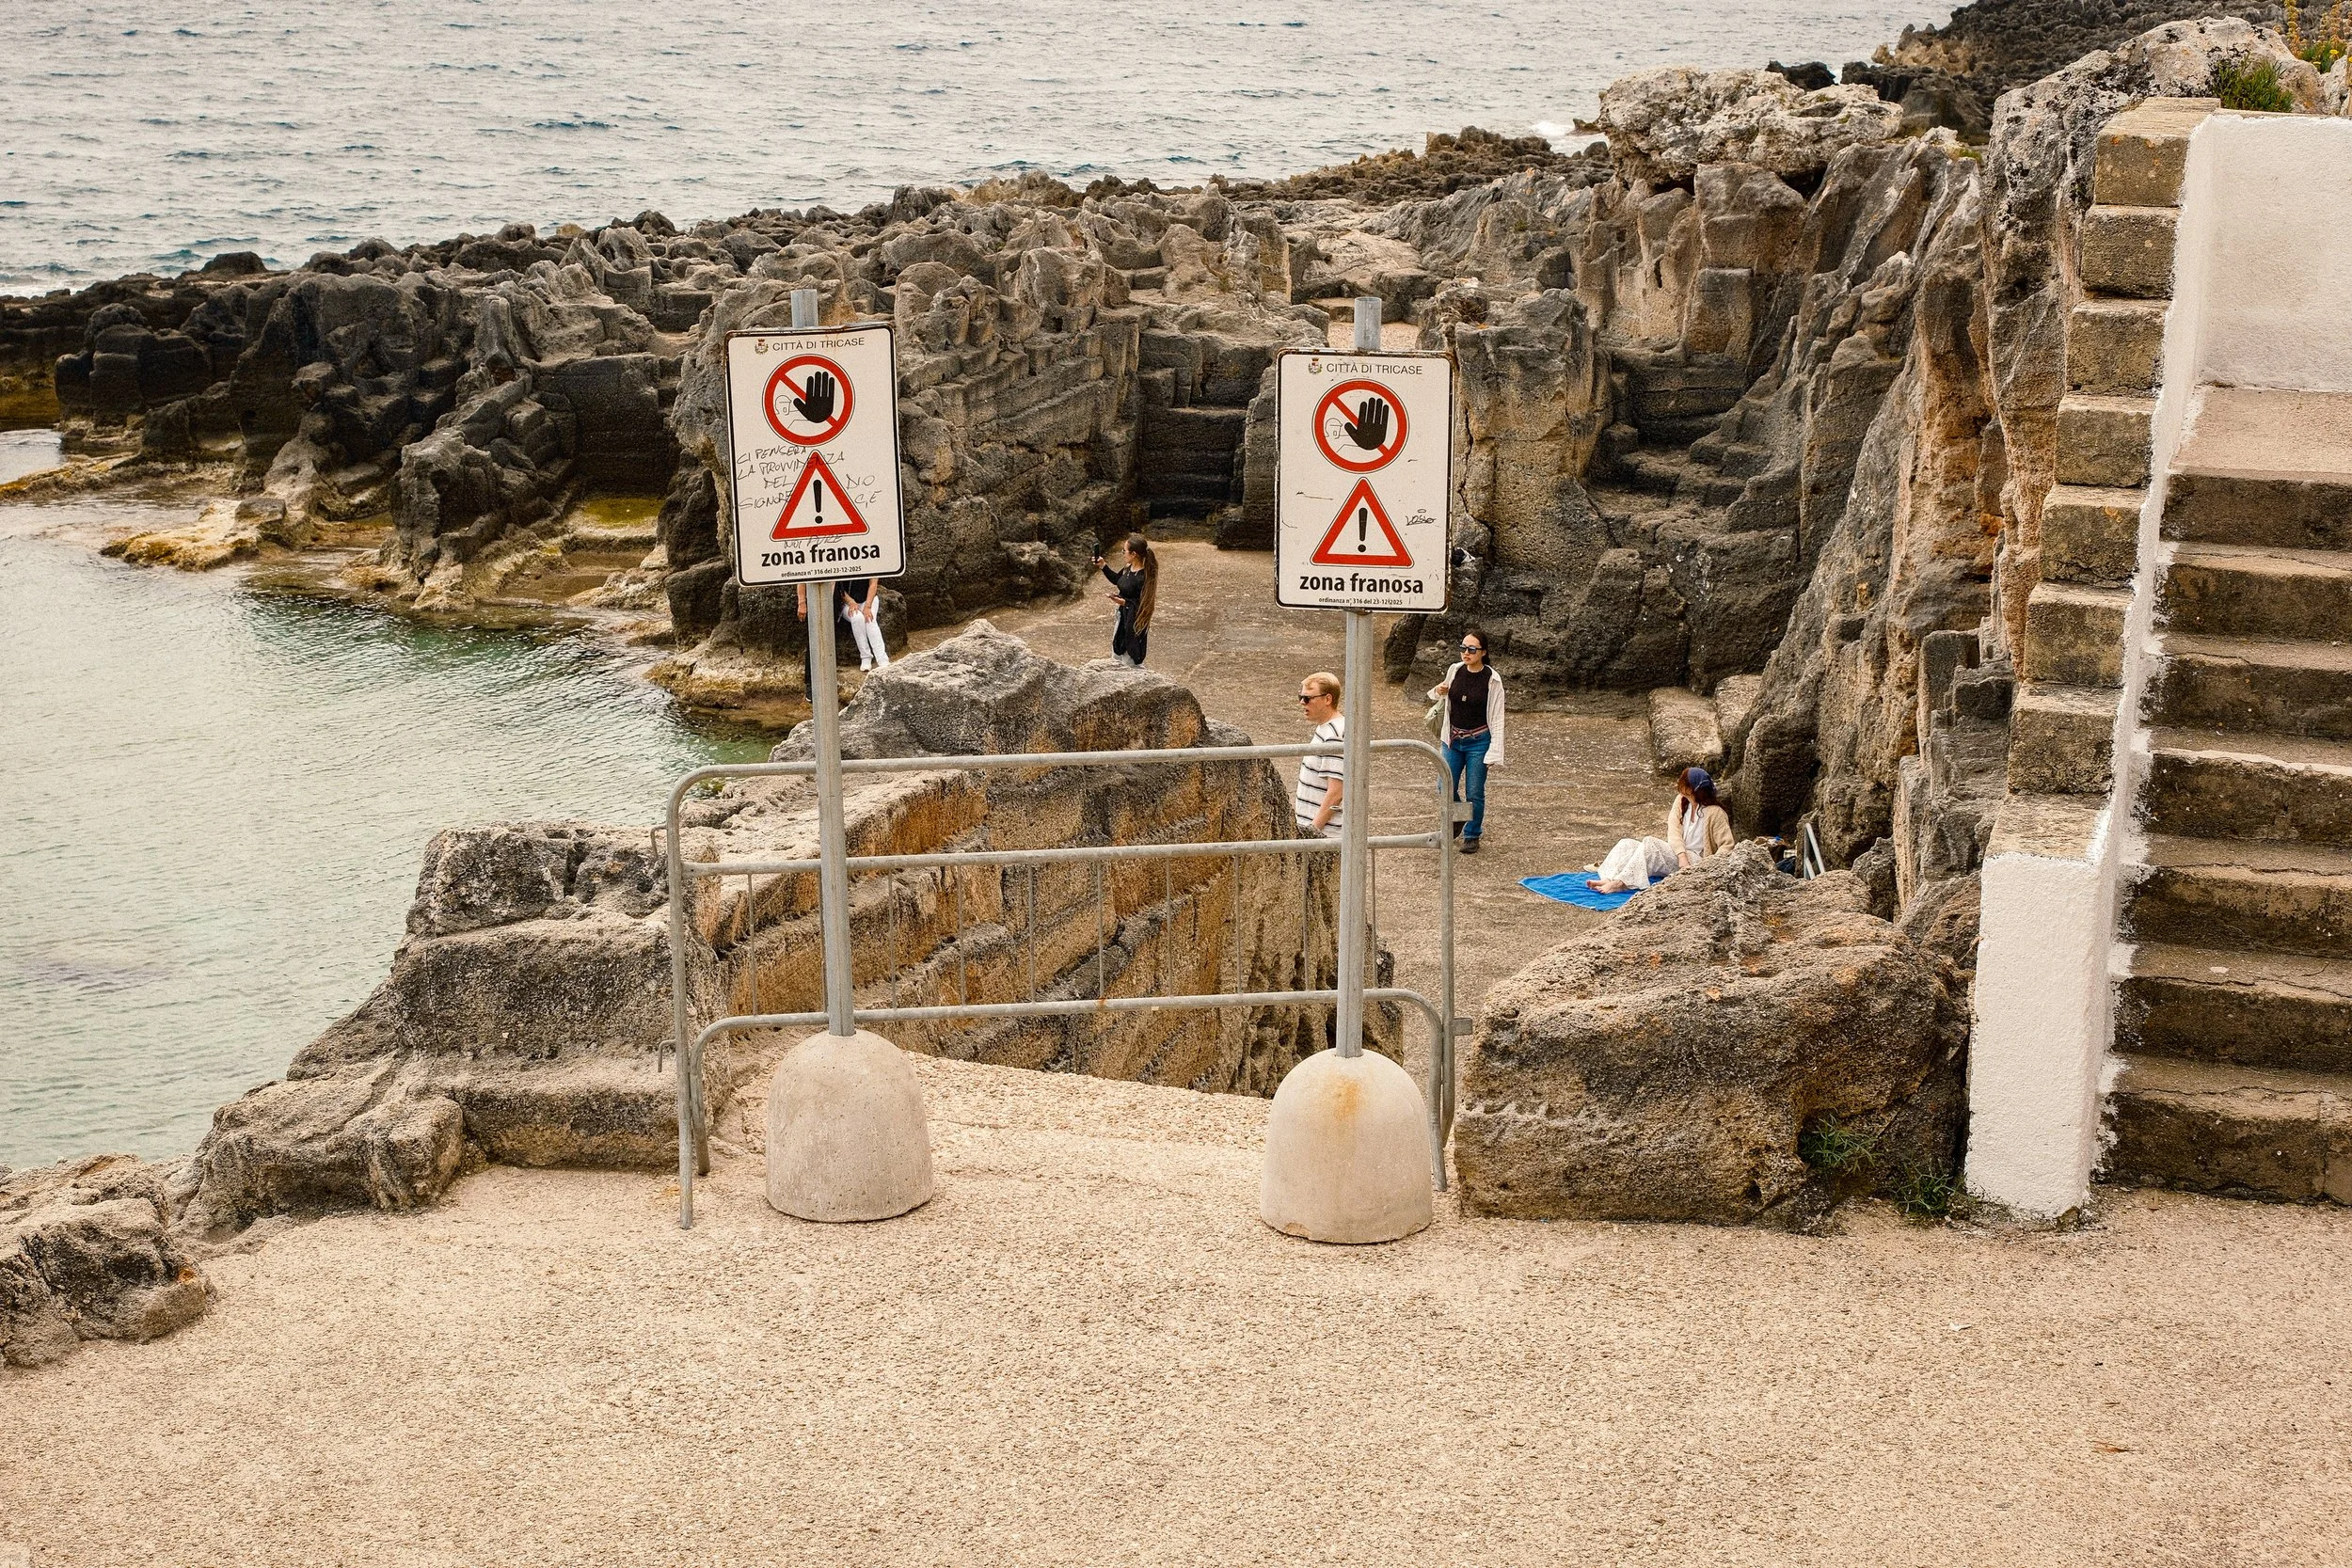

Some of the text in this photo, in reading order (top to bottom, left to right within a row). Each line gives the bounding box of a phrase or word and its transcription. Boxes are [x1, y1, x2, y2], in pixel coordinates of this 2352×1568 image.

[772, 338, 865, 351] CITTÀ DI TRICASE
[1327, 362, 1422, 374] CITTÀ DI TRICASE
[738, 465, 755, 480] LA
[764, 475, 795, 489] DEL
[846, 473, 875, 489] NO
[761, 545, 881, 567] zona franosa
[834, 565, 862, 574] 23-12-2025
[1299, 573, 1423, 594] zona franosa
